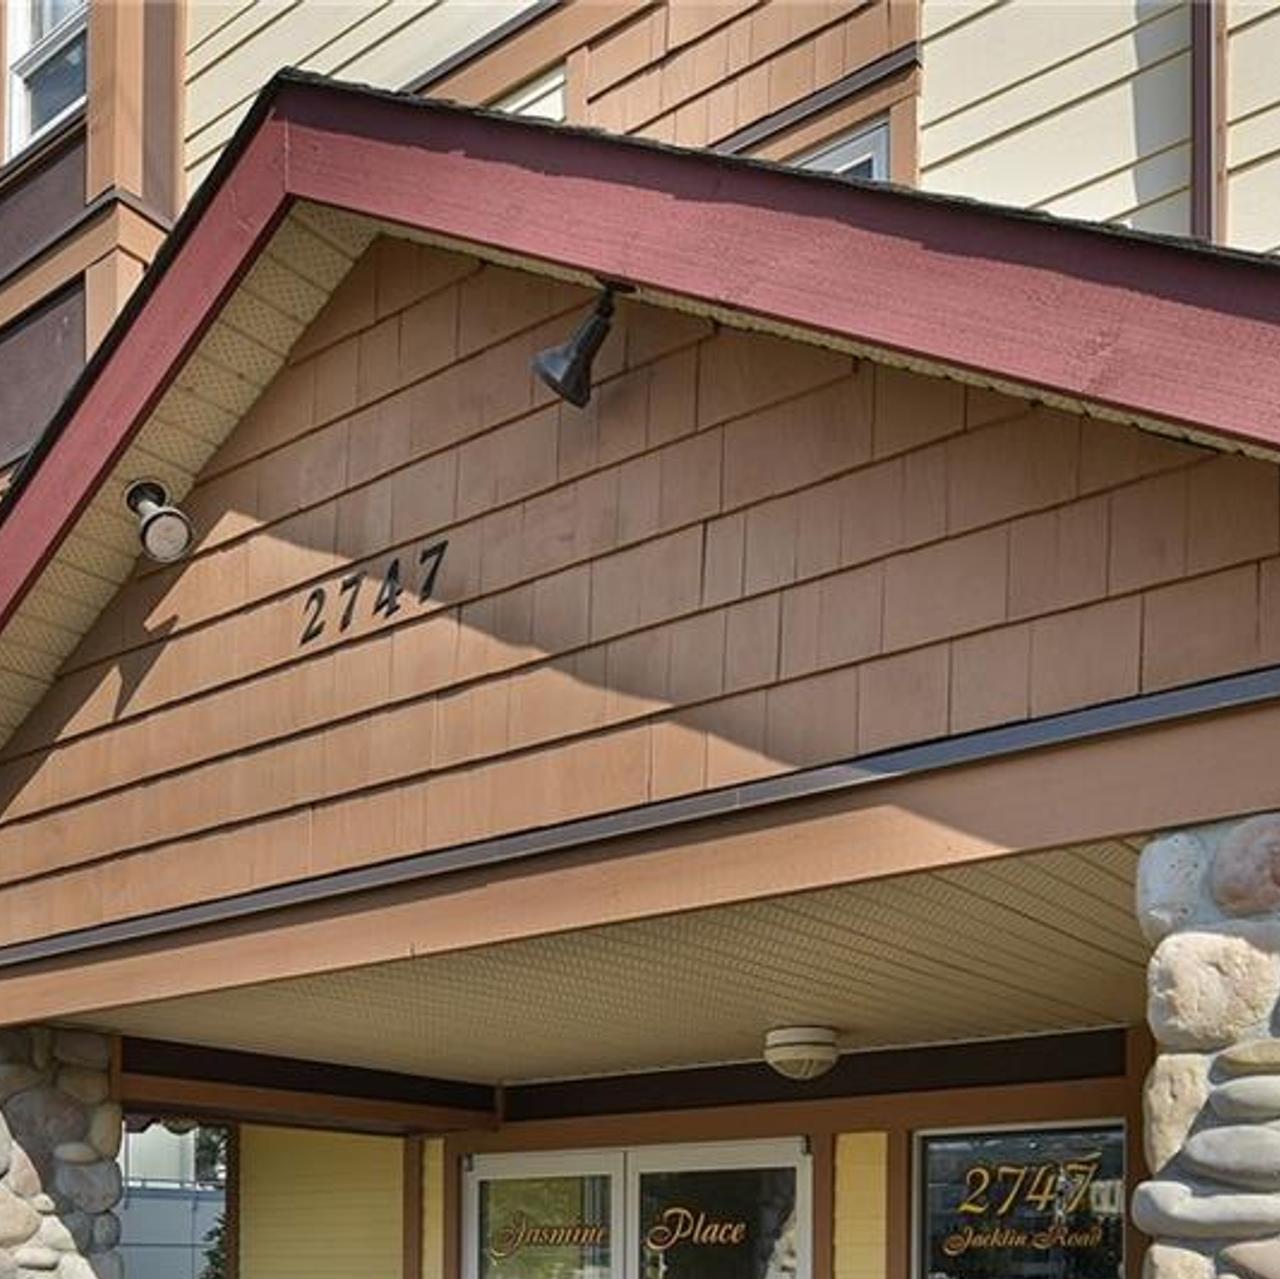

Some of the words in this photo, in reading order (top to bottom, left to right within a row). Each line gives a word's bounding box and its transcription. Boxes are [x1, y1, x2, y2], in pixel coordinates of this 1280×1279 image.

[298, 539, 450, 648] 2747
[957, 1160, 1100, 1217] 2747
[646, 1207, 746, 1252] Place
